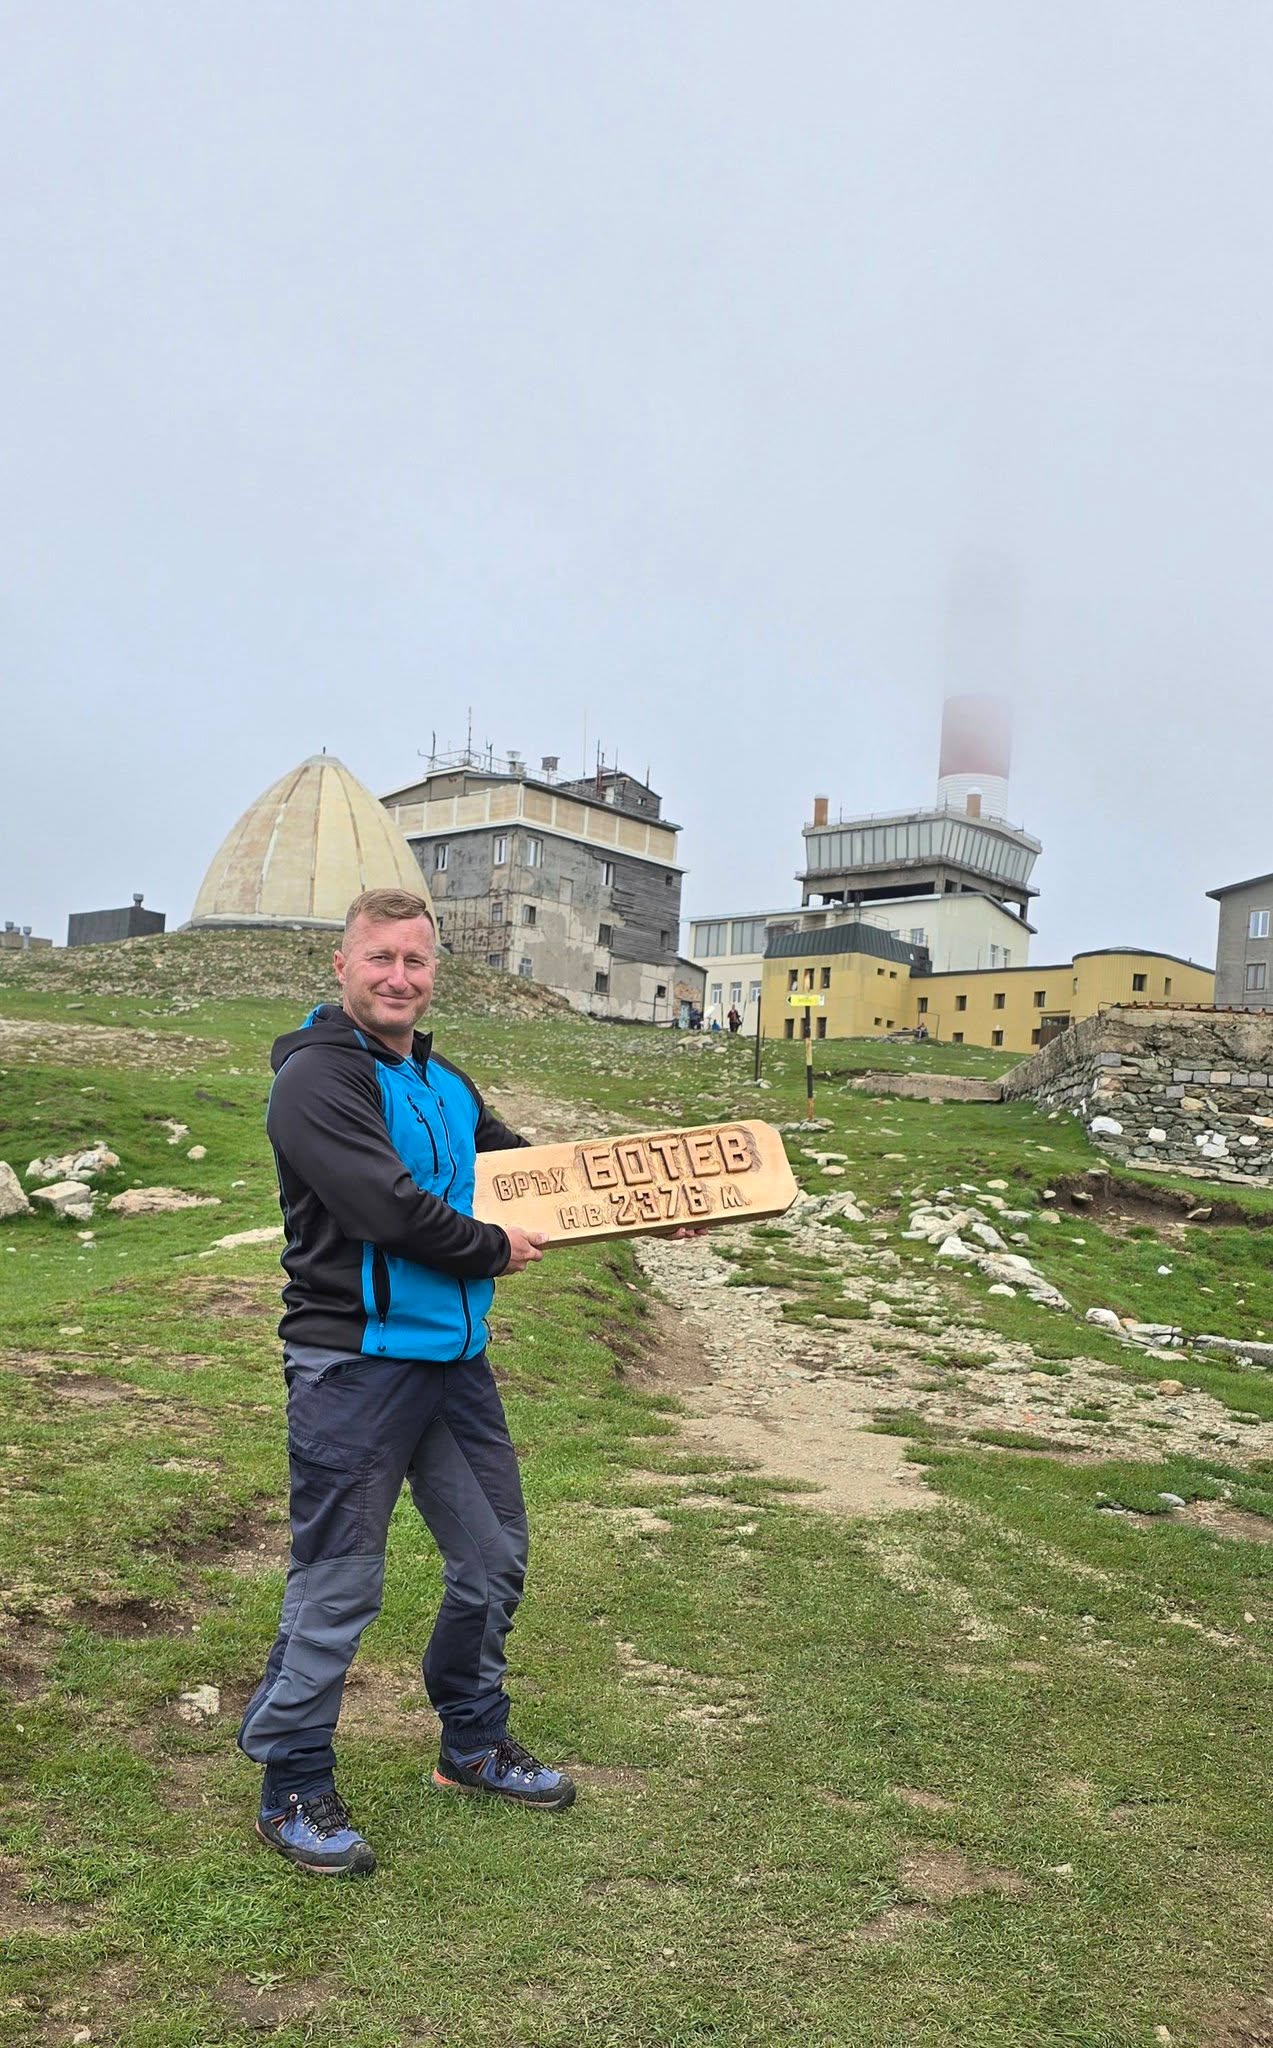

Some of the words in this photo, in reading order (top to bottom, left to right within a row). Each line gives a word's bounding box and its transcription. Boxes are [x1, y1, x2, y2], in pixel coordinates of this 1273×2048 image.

[496, 1168, 568, 1201] ВРЪХ
[582, 1130, 752, 1190] БОТЕВ
[610, 1182, 709, 1225] 2376
